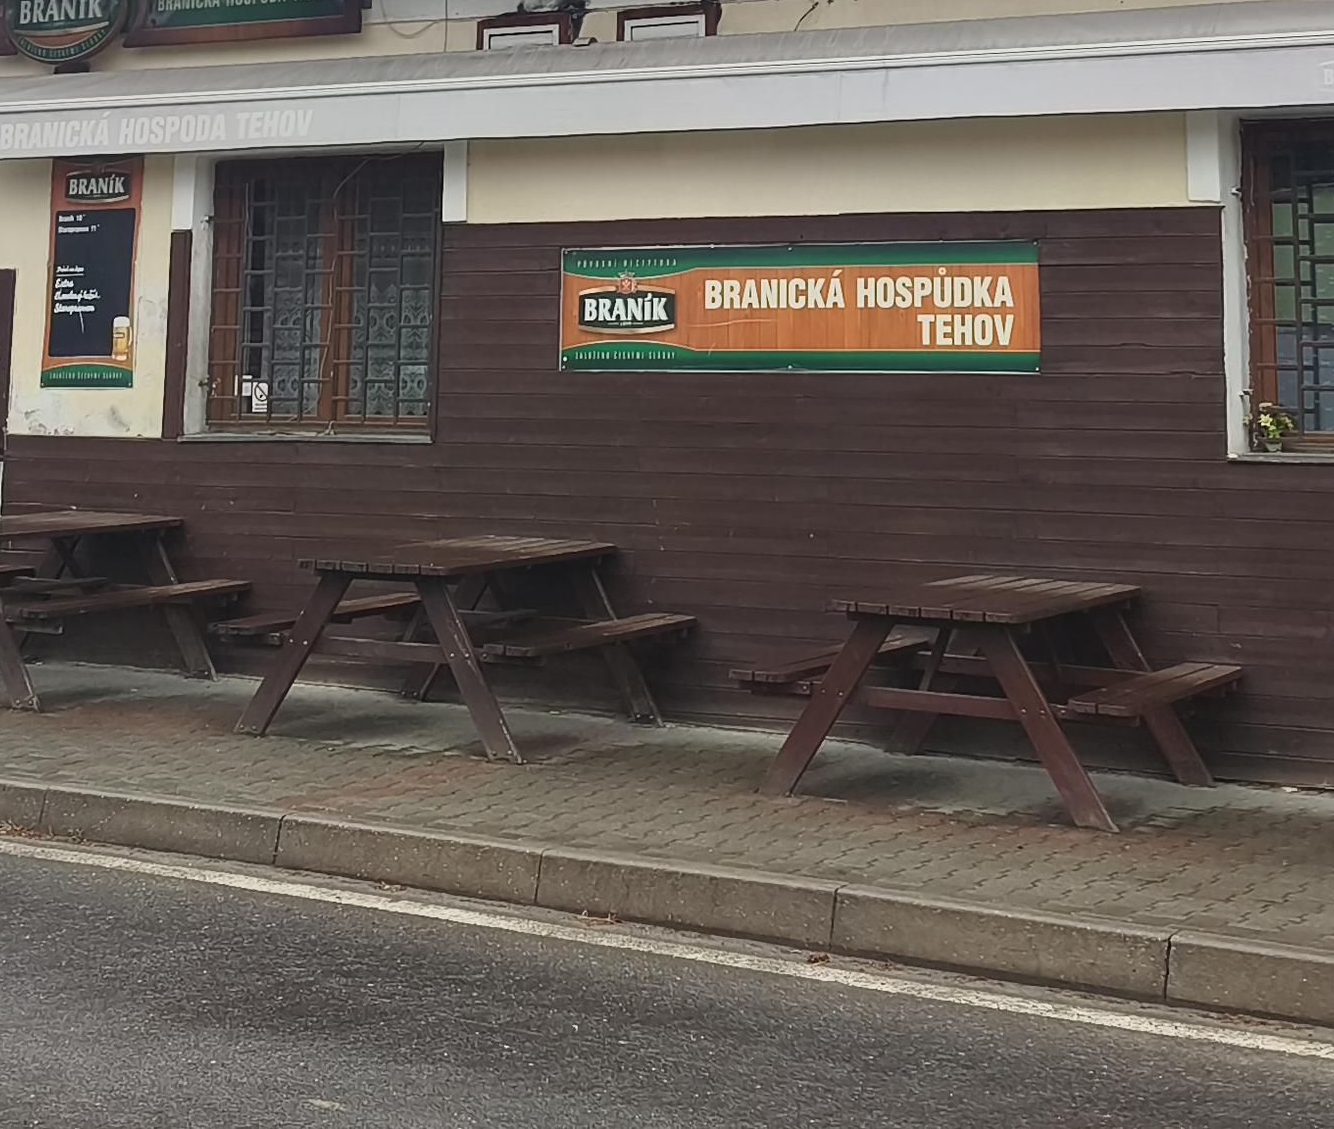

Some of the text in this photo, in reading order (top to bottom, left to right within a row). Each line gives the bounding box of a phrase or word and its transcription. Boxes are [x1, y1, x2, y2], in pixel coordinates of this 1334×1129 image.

[0, 110, 314, 150] BRANICKÁ HOSPODA TEHOV
[68, 174, 125, 195] BRANÍK
[704, 267, 1014, 309] BRANICKÁ HOSPŮDKA
[584, 293, 668, 321] BRANÍK
[917, 314, 1014, 346] TEHOV
